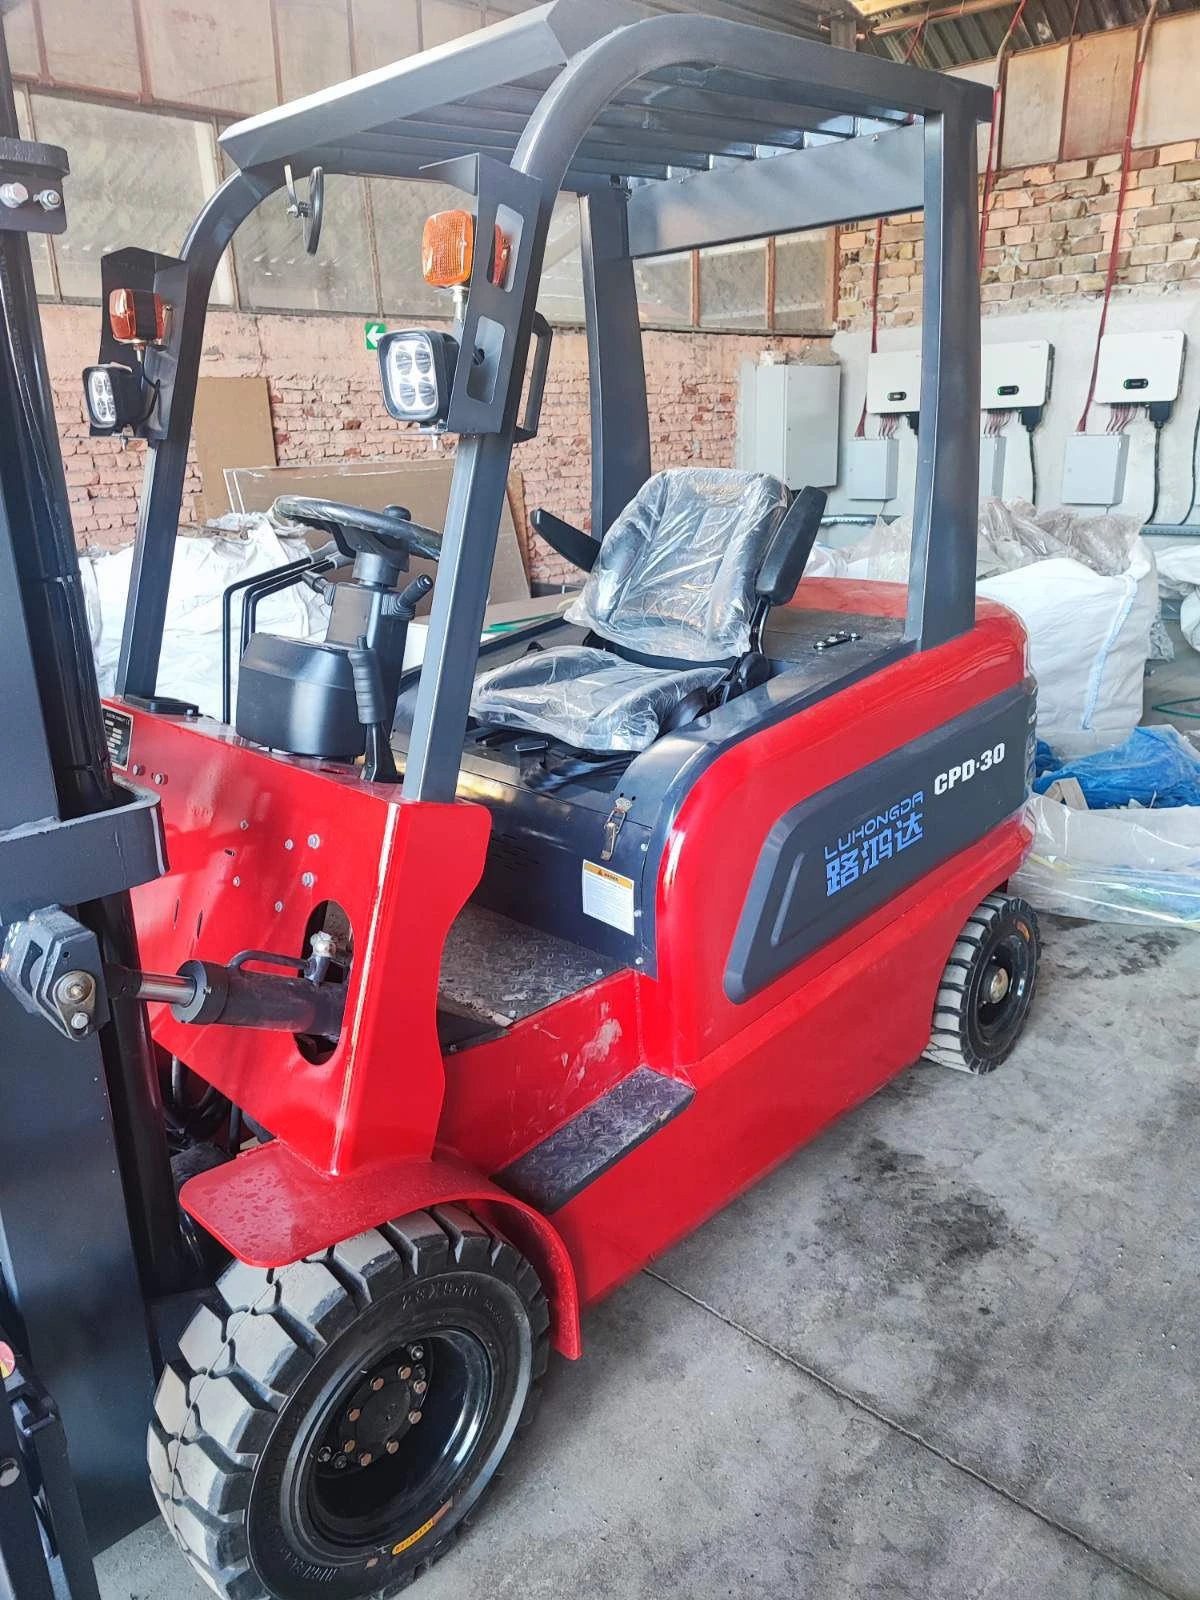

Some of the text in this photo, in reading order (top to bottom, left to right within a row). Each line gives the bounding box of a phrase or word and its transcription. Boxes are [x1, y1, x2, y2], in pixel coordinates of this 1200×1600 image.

[825, 791, 924, 860] LUHONGDA
[826, 812, 924, 897] 路鸿达
